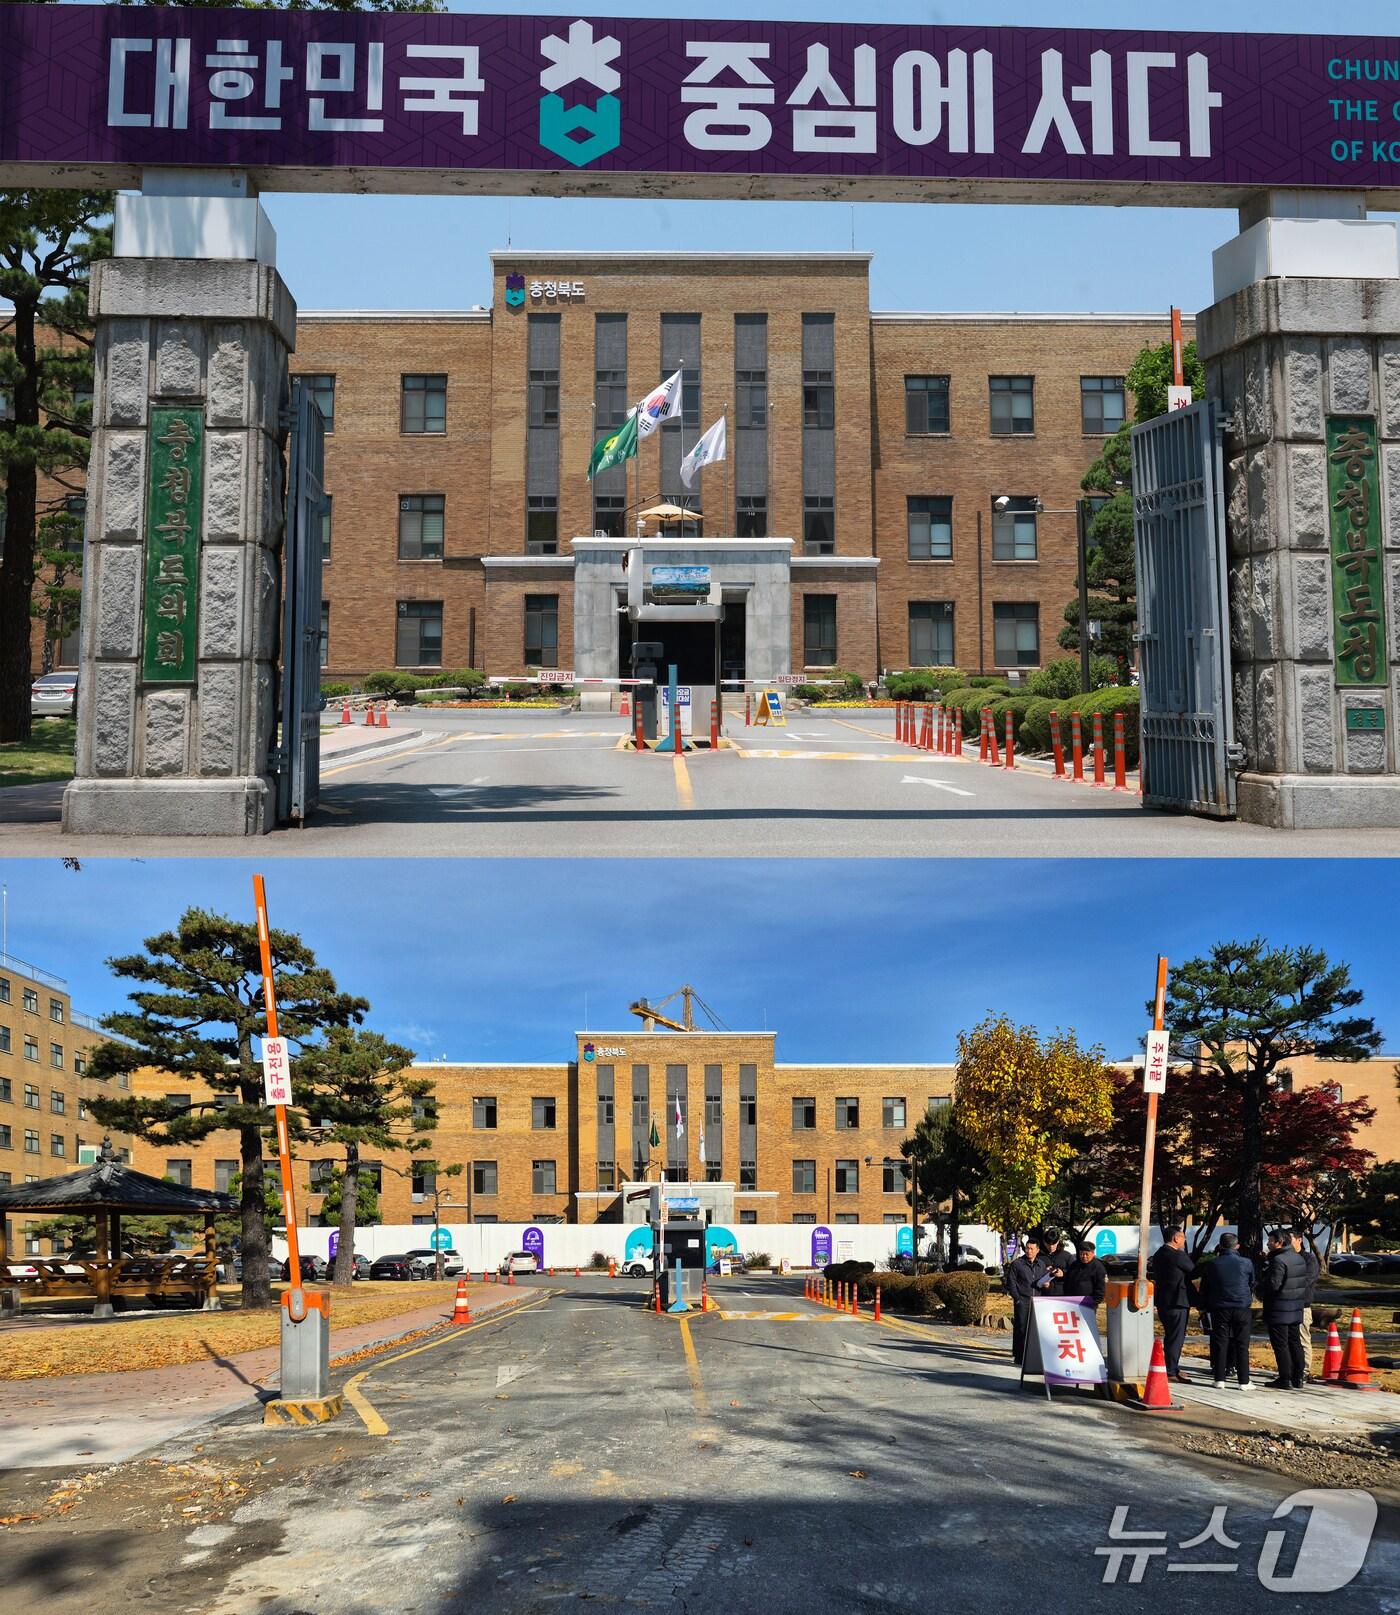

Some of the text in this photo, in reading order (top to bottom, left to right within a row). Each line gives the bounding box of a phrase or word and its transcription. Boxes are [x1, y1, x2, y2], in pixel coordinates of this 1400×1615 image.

[1328, 59, 1400, 80] CHUN
[107, 38, 1222, 157] 대한민국 중심에 서다
[1328, 100, 1378, 121] THE
[1331, 140, 1364, 161] OF
[529, 281, 586, 298] 충청북도
[153, 418, 195, 667] 충청북도의회
[1329, 427, 1381, 679] 충청북도청
[540, 672, 574, 682] 진입금지
[267, 1042, 286, 1101] 출구전용
[1149, 1042, 1165, 1082] 주차끝
[1053, 1310, 1086, 1363] 만차
